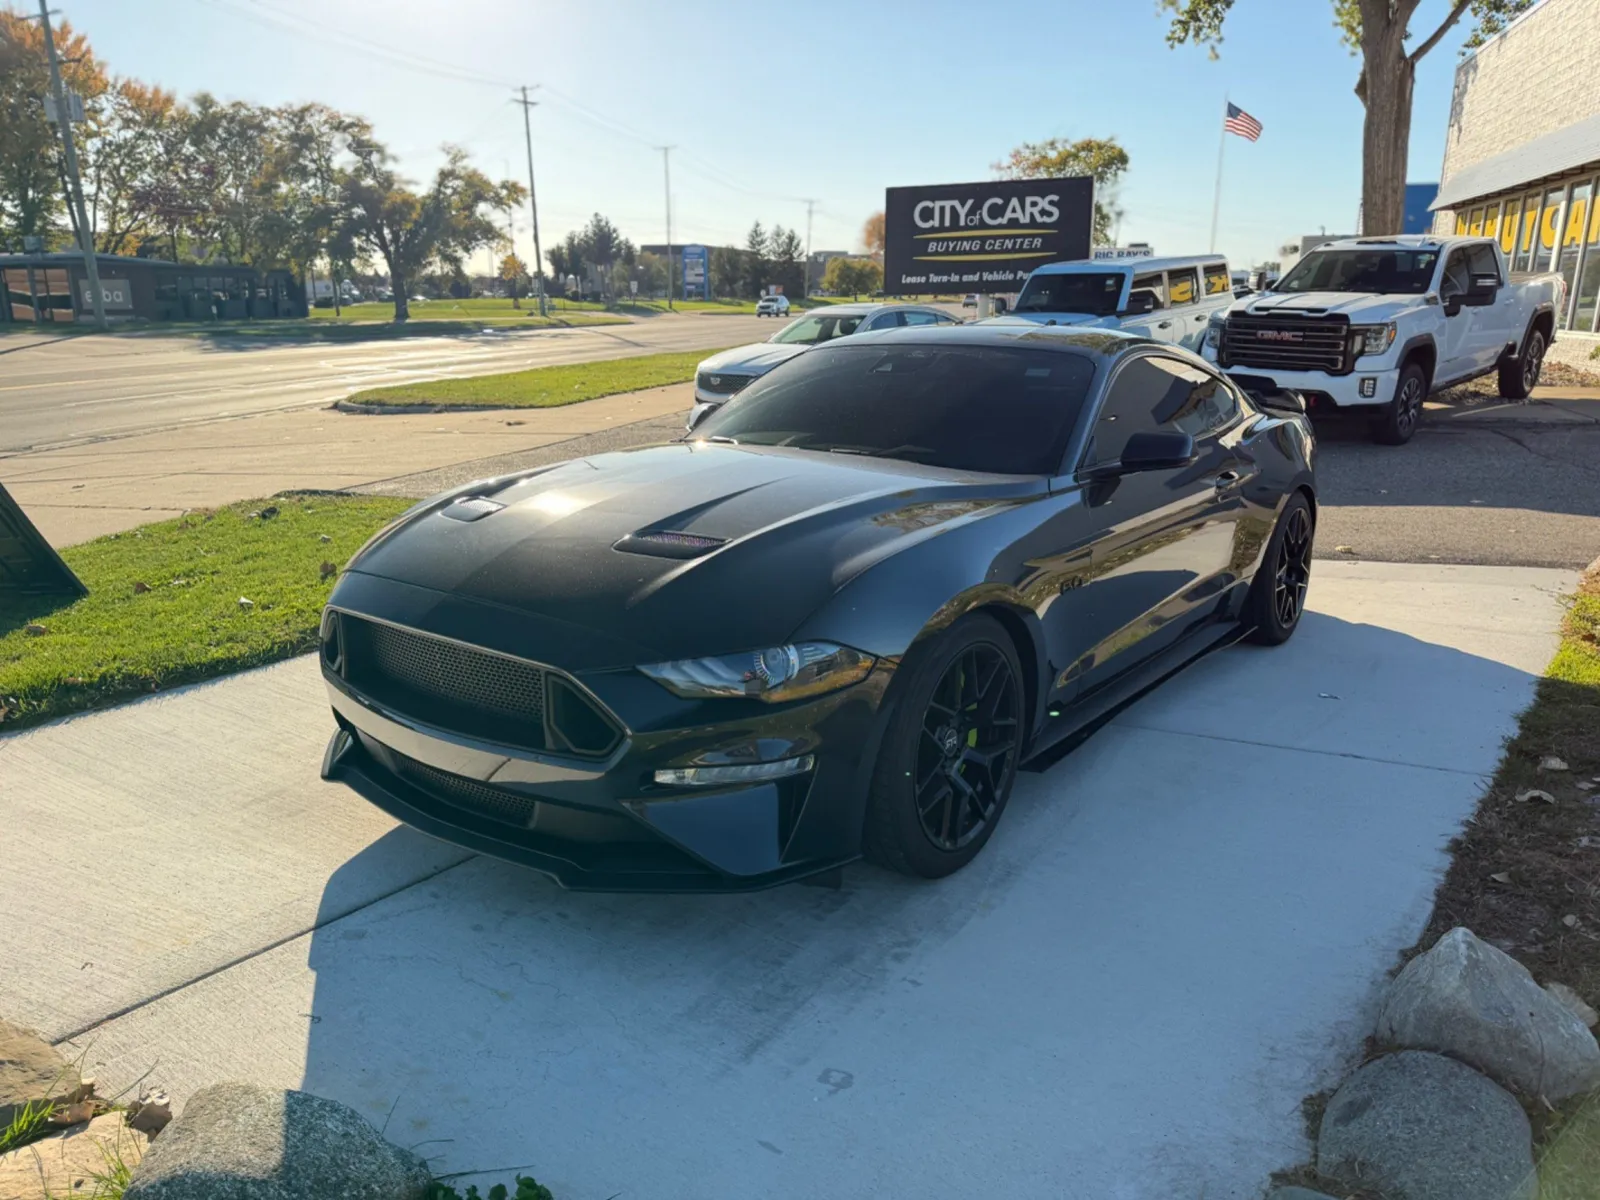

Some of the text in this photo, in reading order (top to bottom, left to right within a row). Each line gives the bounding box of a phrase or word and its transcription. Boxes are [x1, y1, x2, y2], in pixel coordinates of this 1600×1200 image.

[913, 194, 1060, 228] CITY of CARS
[927, 237, 1042, 253] BUYING CENTER
[901, 274, 926, 284] Lease
[962, 272, 979, 281] and
[982, 270, 1013, 281] Vehicle
[85, 287, 123, 302] eba
[1257, 330, 1304, 341] GMC
